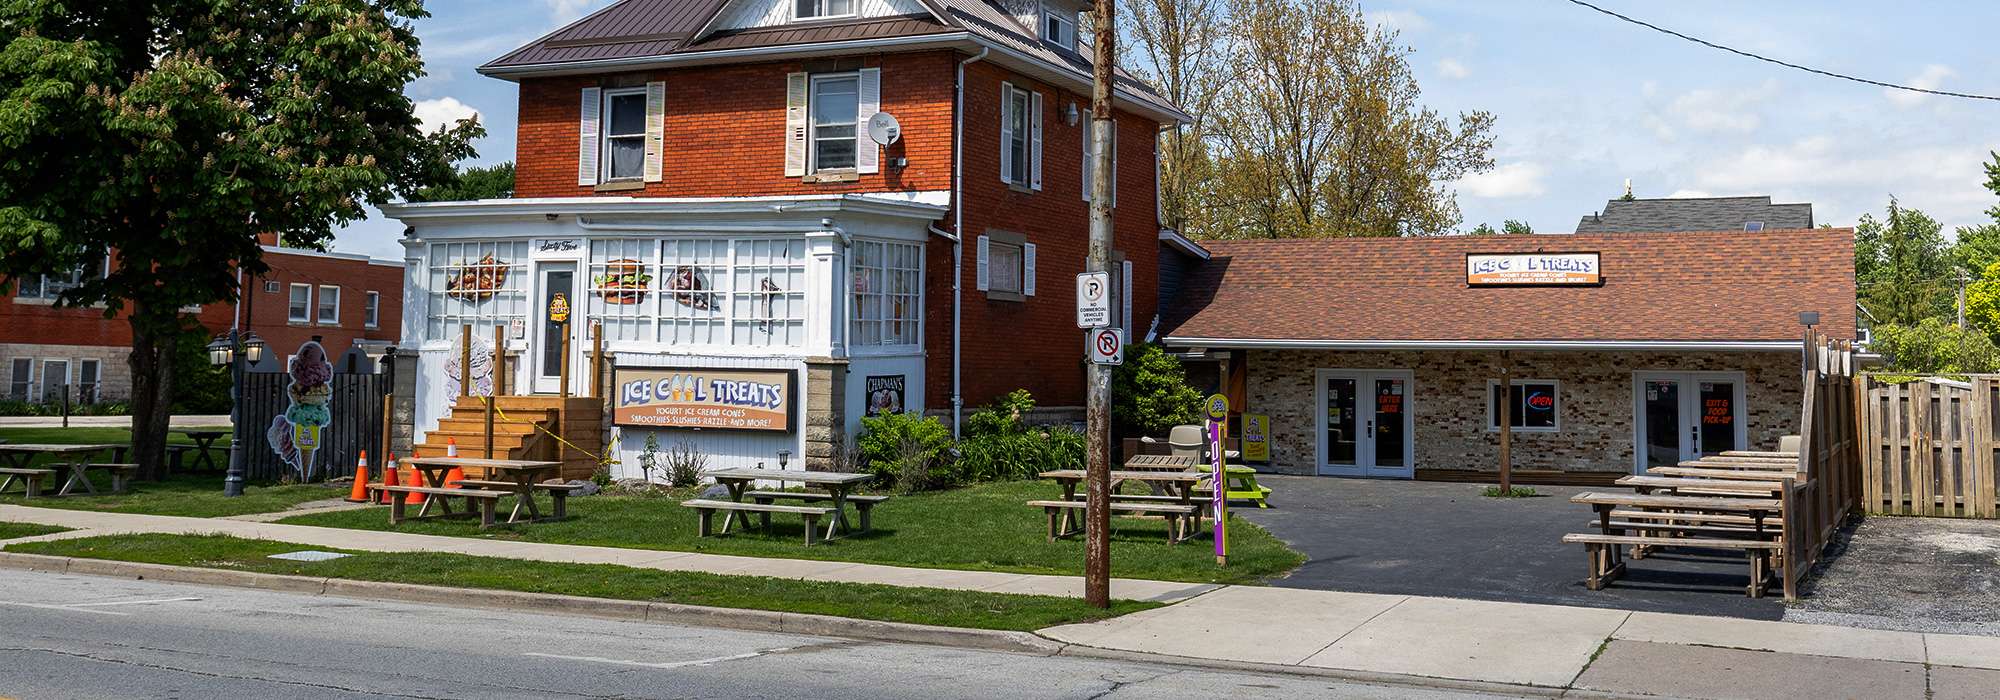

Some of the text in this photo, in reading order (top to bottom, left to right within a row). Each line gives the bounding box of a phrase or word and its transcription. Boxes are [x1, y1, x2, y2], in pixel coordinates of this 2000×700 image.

[1473, 259, 1495, 274] ICE
[1540, 257, 1593, 272] TREATS
[867, 377, 903, 393] CHAPMAN'S
[622, 379, 651, 406] ICE
[710, 379, 783, 409] TREATS
[1530, 396, 1553, 406] OPEN
[655, 407, 746, 417] YOGURT ICE CREAM CONES
[1211, 440, 1222, 526] OPEN
